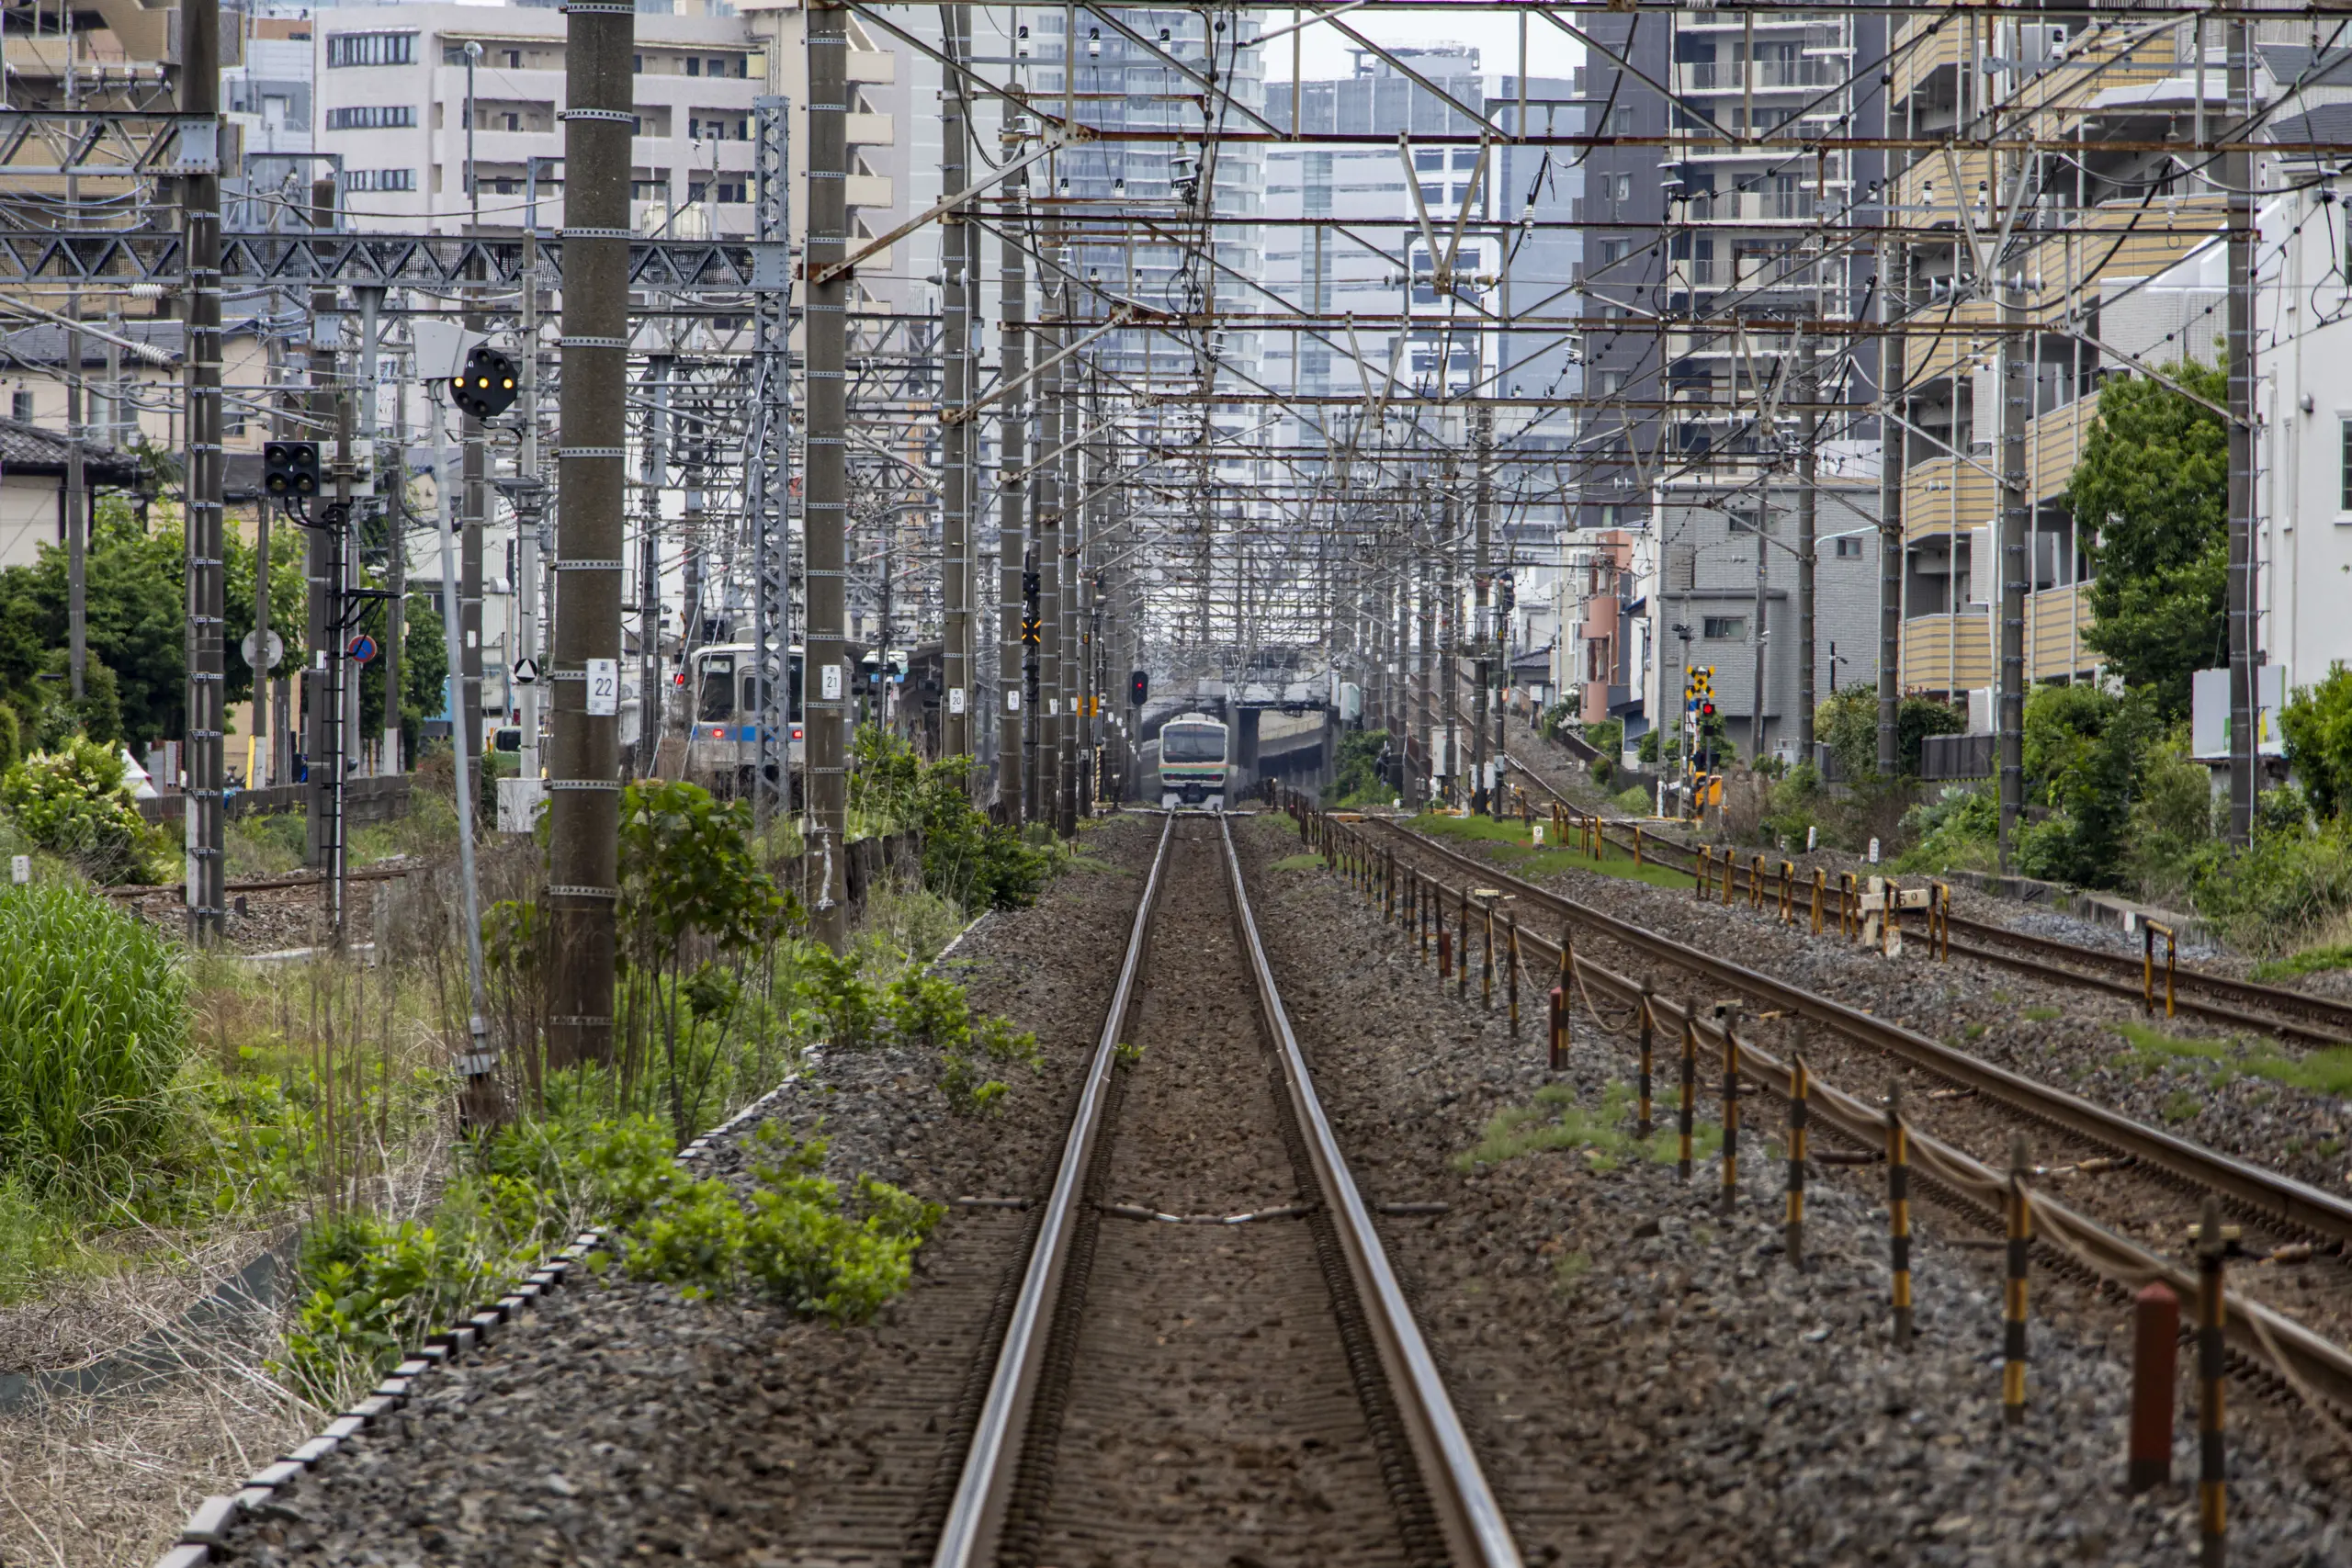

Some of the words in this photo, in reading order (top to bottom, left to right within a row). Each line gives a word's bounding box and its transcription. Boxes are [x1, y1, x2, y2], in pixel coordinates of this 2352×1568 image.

[595, 678, 612, 696] 22
[827, 676, 837, 688] 21
[953, 696, 961, 705] 20
